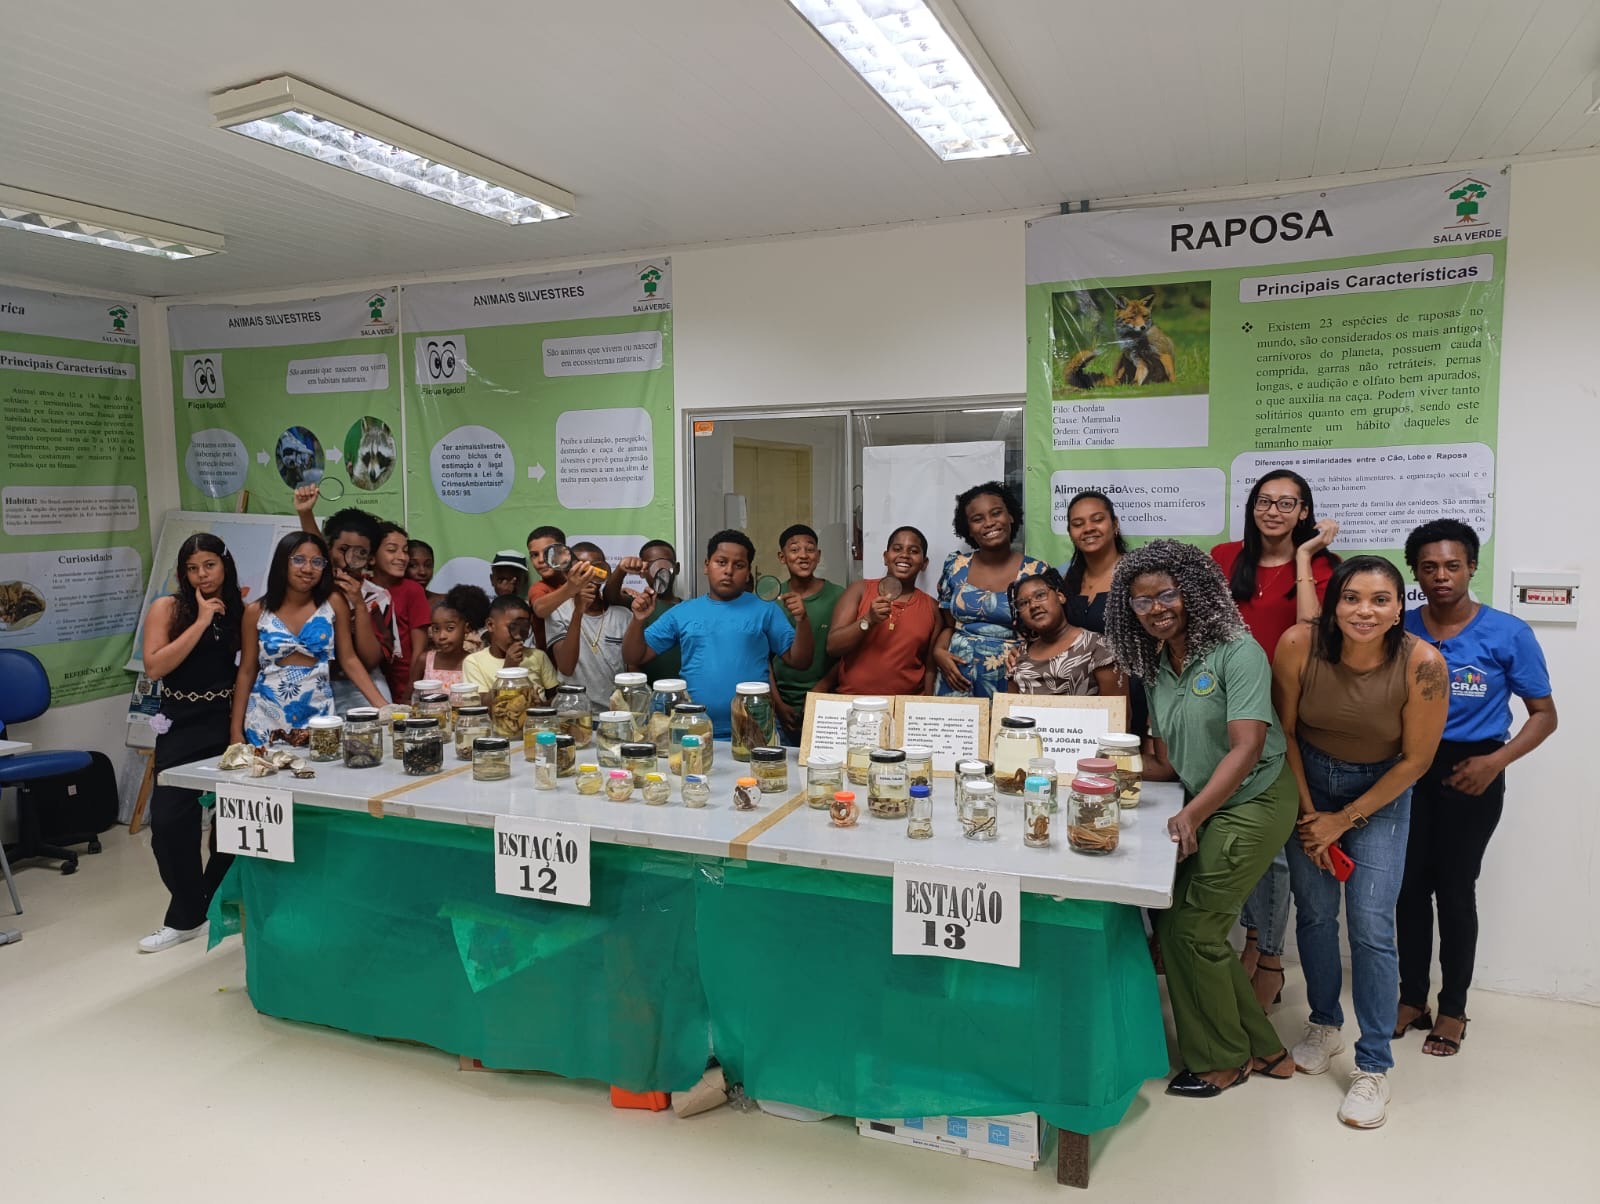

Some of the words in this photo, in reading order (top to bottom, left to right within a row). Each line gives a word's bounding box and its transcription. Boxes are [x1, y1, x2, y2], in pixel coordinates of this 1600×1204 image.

[1170, 208, 1334, 253] RAPOSA
[1433, 233, 1460, 244] SALA
[1461, 228, 1503, 241] VERDE
[1257, 277, 1340, 298] Principais
[1345, 262, 1478, 289] Características
[473, 292, 516, 307] ANIMAIS
[518, 286, 584, 303] SILVESTRES
[650, 303, 671, 311] VERDE
[228, 316, 263, 328] ANIMAIS
[265, 311, 321, 326] SILVESTRES
[1268, 321, 1310, 333] Existem
[1320, 319, 1333, 328] 23
[1342, 314, 1387, 328] espécies
[1396, 313, 1409, 323] de
[1418, 309, 1461, 323] raposas
[1470, 308, 1483, 316] no
[1257, 337, 1296, 348] mundo,
[1300, 336, 1318, 345] são
[1322, 330, 1392, 344] considerados
[1396, 331, 1408, 339] os
[1412, 327, 1438, 337] mais
[1443, 324, 1483, 337] antigos
[1257, 351, 1311, 362] carnívoros
[1320, 349, 1333, 359] do
[1342, 347, 1383, 360] planeta,
[1392, 341, 1441, 356] possuem
[1451, 339, 1482, 349] cauda
[0, 355, 53, 370] Principais
[1256, 365, 1308, 379] comprida,
[1318, 365, 1350, 376] garras
[1359, 362, 1378, 372] não
[1256, 382, 1295, 394] longas,
[1297, 381, 1304, 390] e
[1307, 376, 1348, 390] audição
[1353, 377, 1358, 387] e
[1363, 374, 1395, 386] olfato
[1399, 373, 1423, 384] bem
[1427, 369, 1480, 383] apurados,
[1266, 397, 1285, 408] que
[1289, 393, 1324, 404] auxilia
[1329, 394, 1341, 403] na
[1345, 393, 1372, 404] caça.
[1378, 390, 1415, 400] Podem
[1420, 387, 1448, 397] viver
[1451, 385, 1480, 396] tanto
[1053, 405, 1069, 413] Filo:
[1073, 404, 1105, 412] Chordata
[1255, 409, 1302, 421] solitários
[1308, 409, 1344, 421] quanto
[1351, 407, 1366, 416] em
[1373, 405, 1414, 418] grupos,
[1420, 402, 1451, 411] sendo
[1457, 401, 1480, 410] este
[1082, 415, 1120, 423] Mammalia
[1255, 424, 1312, 437] geralmente
[1326, 423, 1342, 432] um
[1357, 420, 1390, 431] hábito
[1404, 417, 1450, 430] daqueles
[1465, 415, 1479, 425] de
[1255, 438, 1299, 449] tamanho
[1302, 438, 1333, 447] maior
[468, 452, 488, 460] bichos
[1255, 458, 1294, 467] Diferenças
[1302, 457, 1352, 465] similaridades
[1387, 454, 1405, 462] Cão,
[1436, 452, 1467, 461] Raposa
[1151, 485, 1179, 493] como
[6, 497, 38, 505] Habitat:
[1113, 499, 1151, 510] equenos
[1154, 498, 1206, 508] mamíferos
[1128, 513, 1167, 522] coelhos.
[1451, 682, 1487, 691] CRAS
[220, 796, 283, 828] ESTAÇÃO
[238, 826, 268, 852] 11
[498, 832, 578, 867] ESTAÇÃO
[520, 865, 557, 895] 12
[906, 880, 1002, 927] ESTAÇÃO
[922, 920, 966, 950] 13
